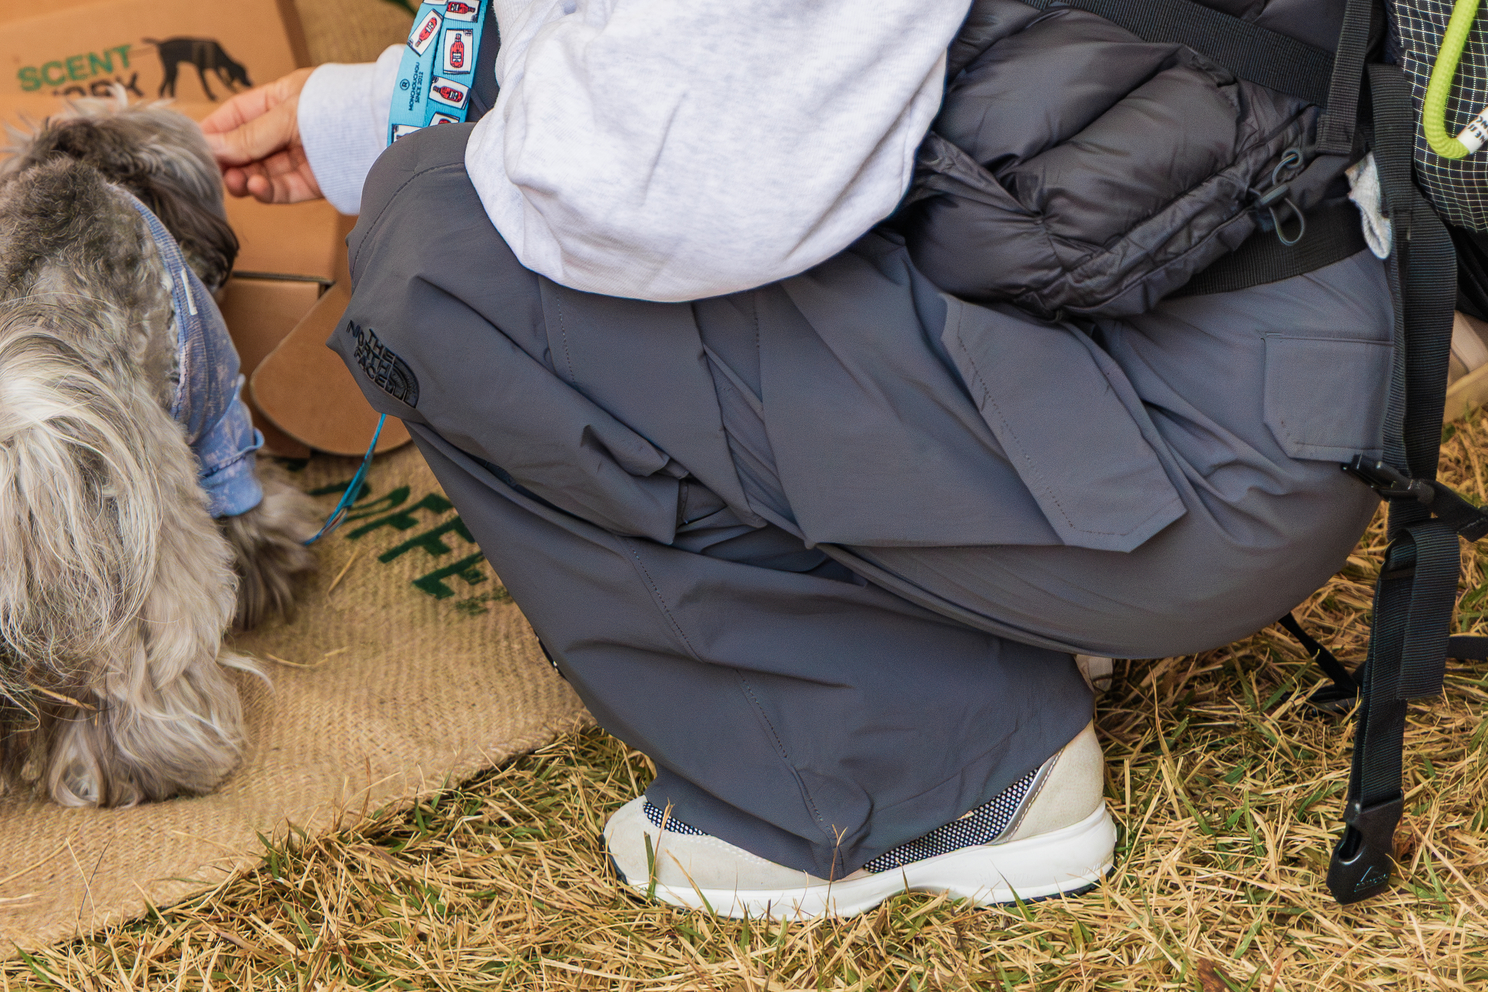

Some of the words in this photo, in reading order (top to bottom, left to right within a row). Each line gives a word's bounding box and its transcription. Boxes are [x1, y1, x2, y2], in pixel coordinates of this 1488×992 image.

[17, 44, 132, 92] SCENT
[345, 320, 393, 376] NORTH
[353, 346, 389, 390] FACE
[367, 327, 396, 365] THE
